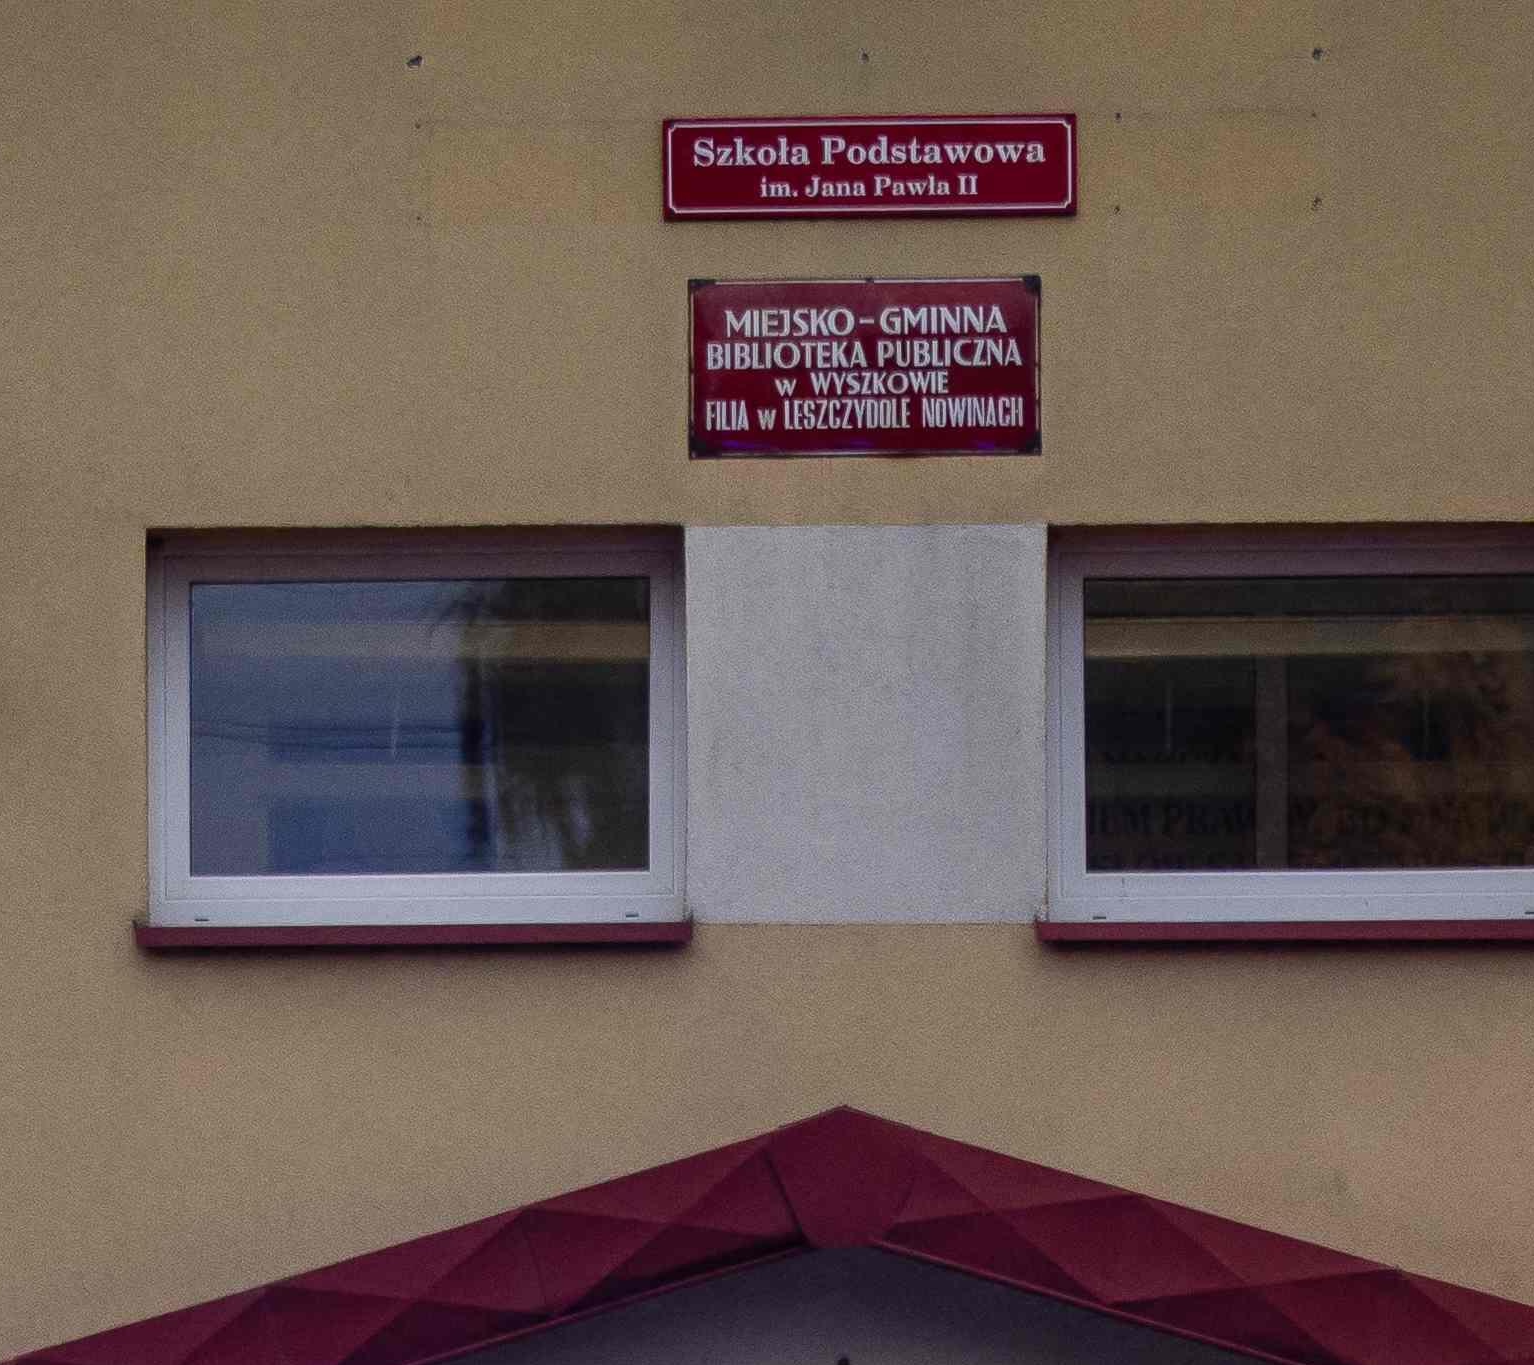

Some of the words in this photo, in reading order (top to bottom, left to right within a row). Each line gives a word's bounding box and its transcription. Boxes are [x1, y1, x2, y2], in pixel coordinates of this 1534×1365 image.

[692, 136, 810, 168] Szkoła
[820, 135, 1045, 166] Podstawowa
[759, 177, 798, 199] im.
[805, 176, 867, 198] Jana
[958, 175, 979, 196] II
[705, 340, 868, 371] BIBLIOTEKA
[877, 337, 1023, 369] PUBLICZNA
[810, 371, 950, 396] WYSZKOWIE
[705, 400, 749, 432] FILIA
[783, 397, 912, 430] LESZCZYDOLE
[922, 396, 1024, 429] NOWINACH
